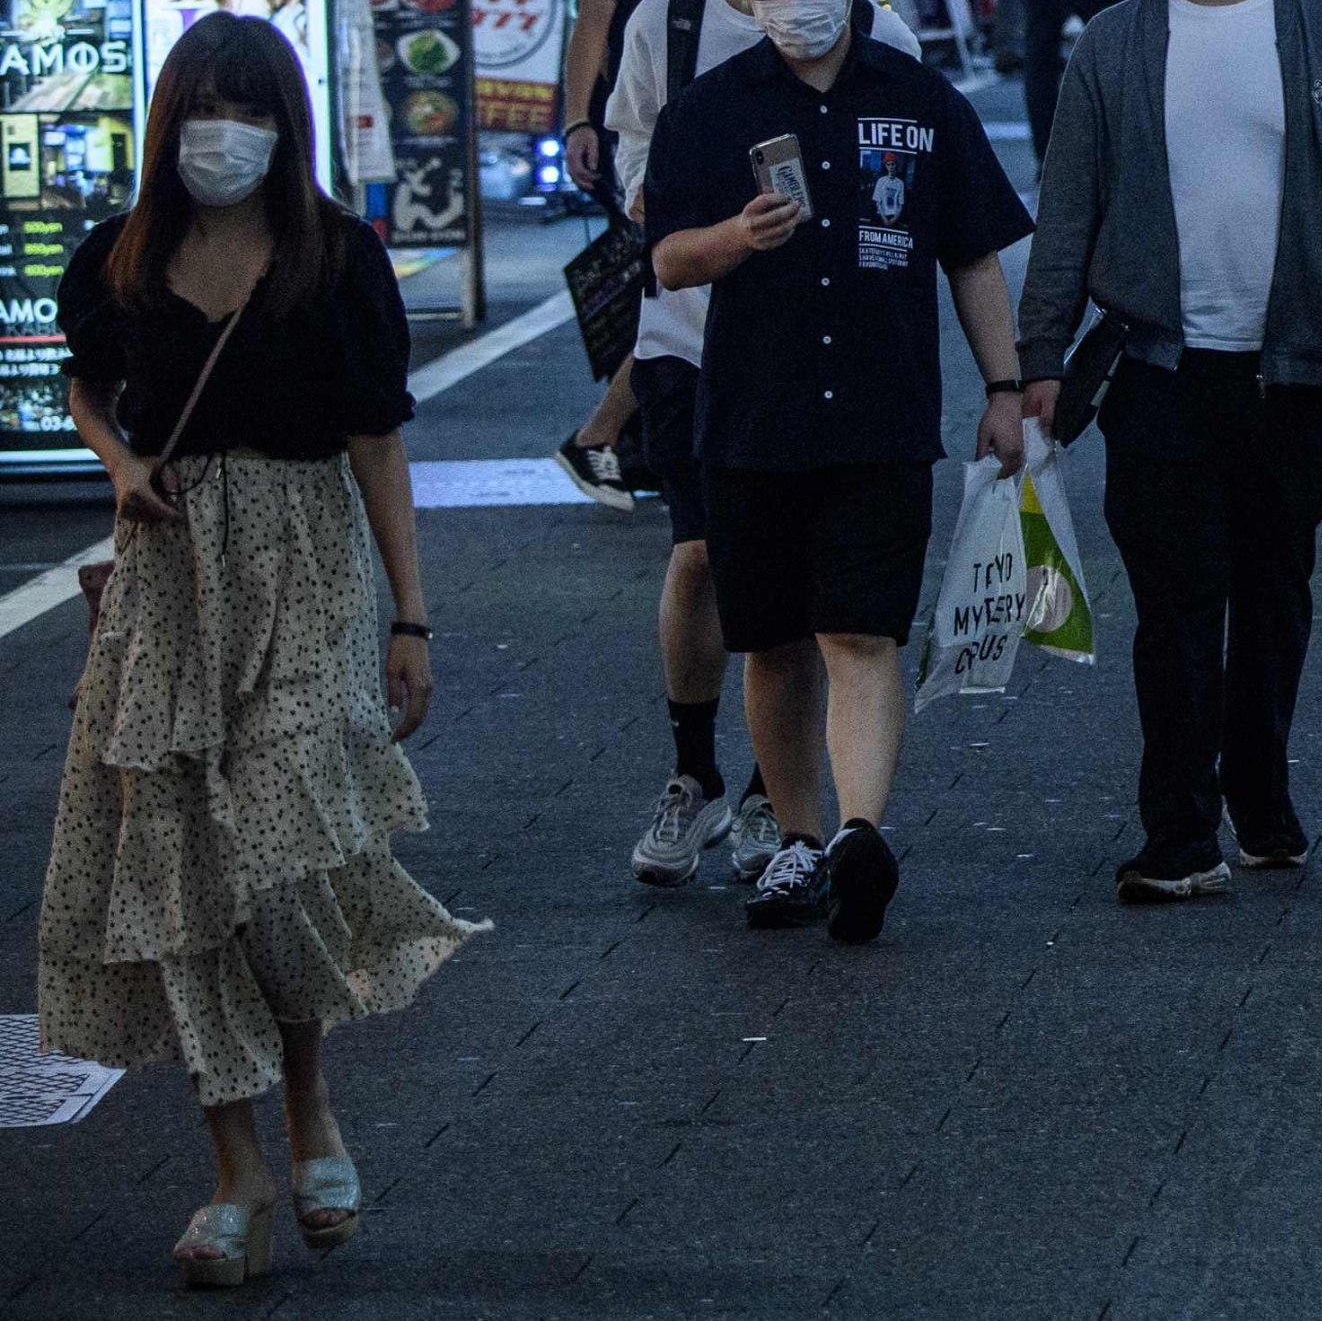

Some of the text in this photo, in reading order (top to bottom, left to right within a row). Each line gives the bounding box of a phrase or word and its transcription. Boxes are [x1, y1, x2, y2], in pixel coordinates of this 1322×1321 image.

[857, 122, 935, 153] LIFE ON
[858, 229, 914, 250] FROM AMERICA
